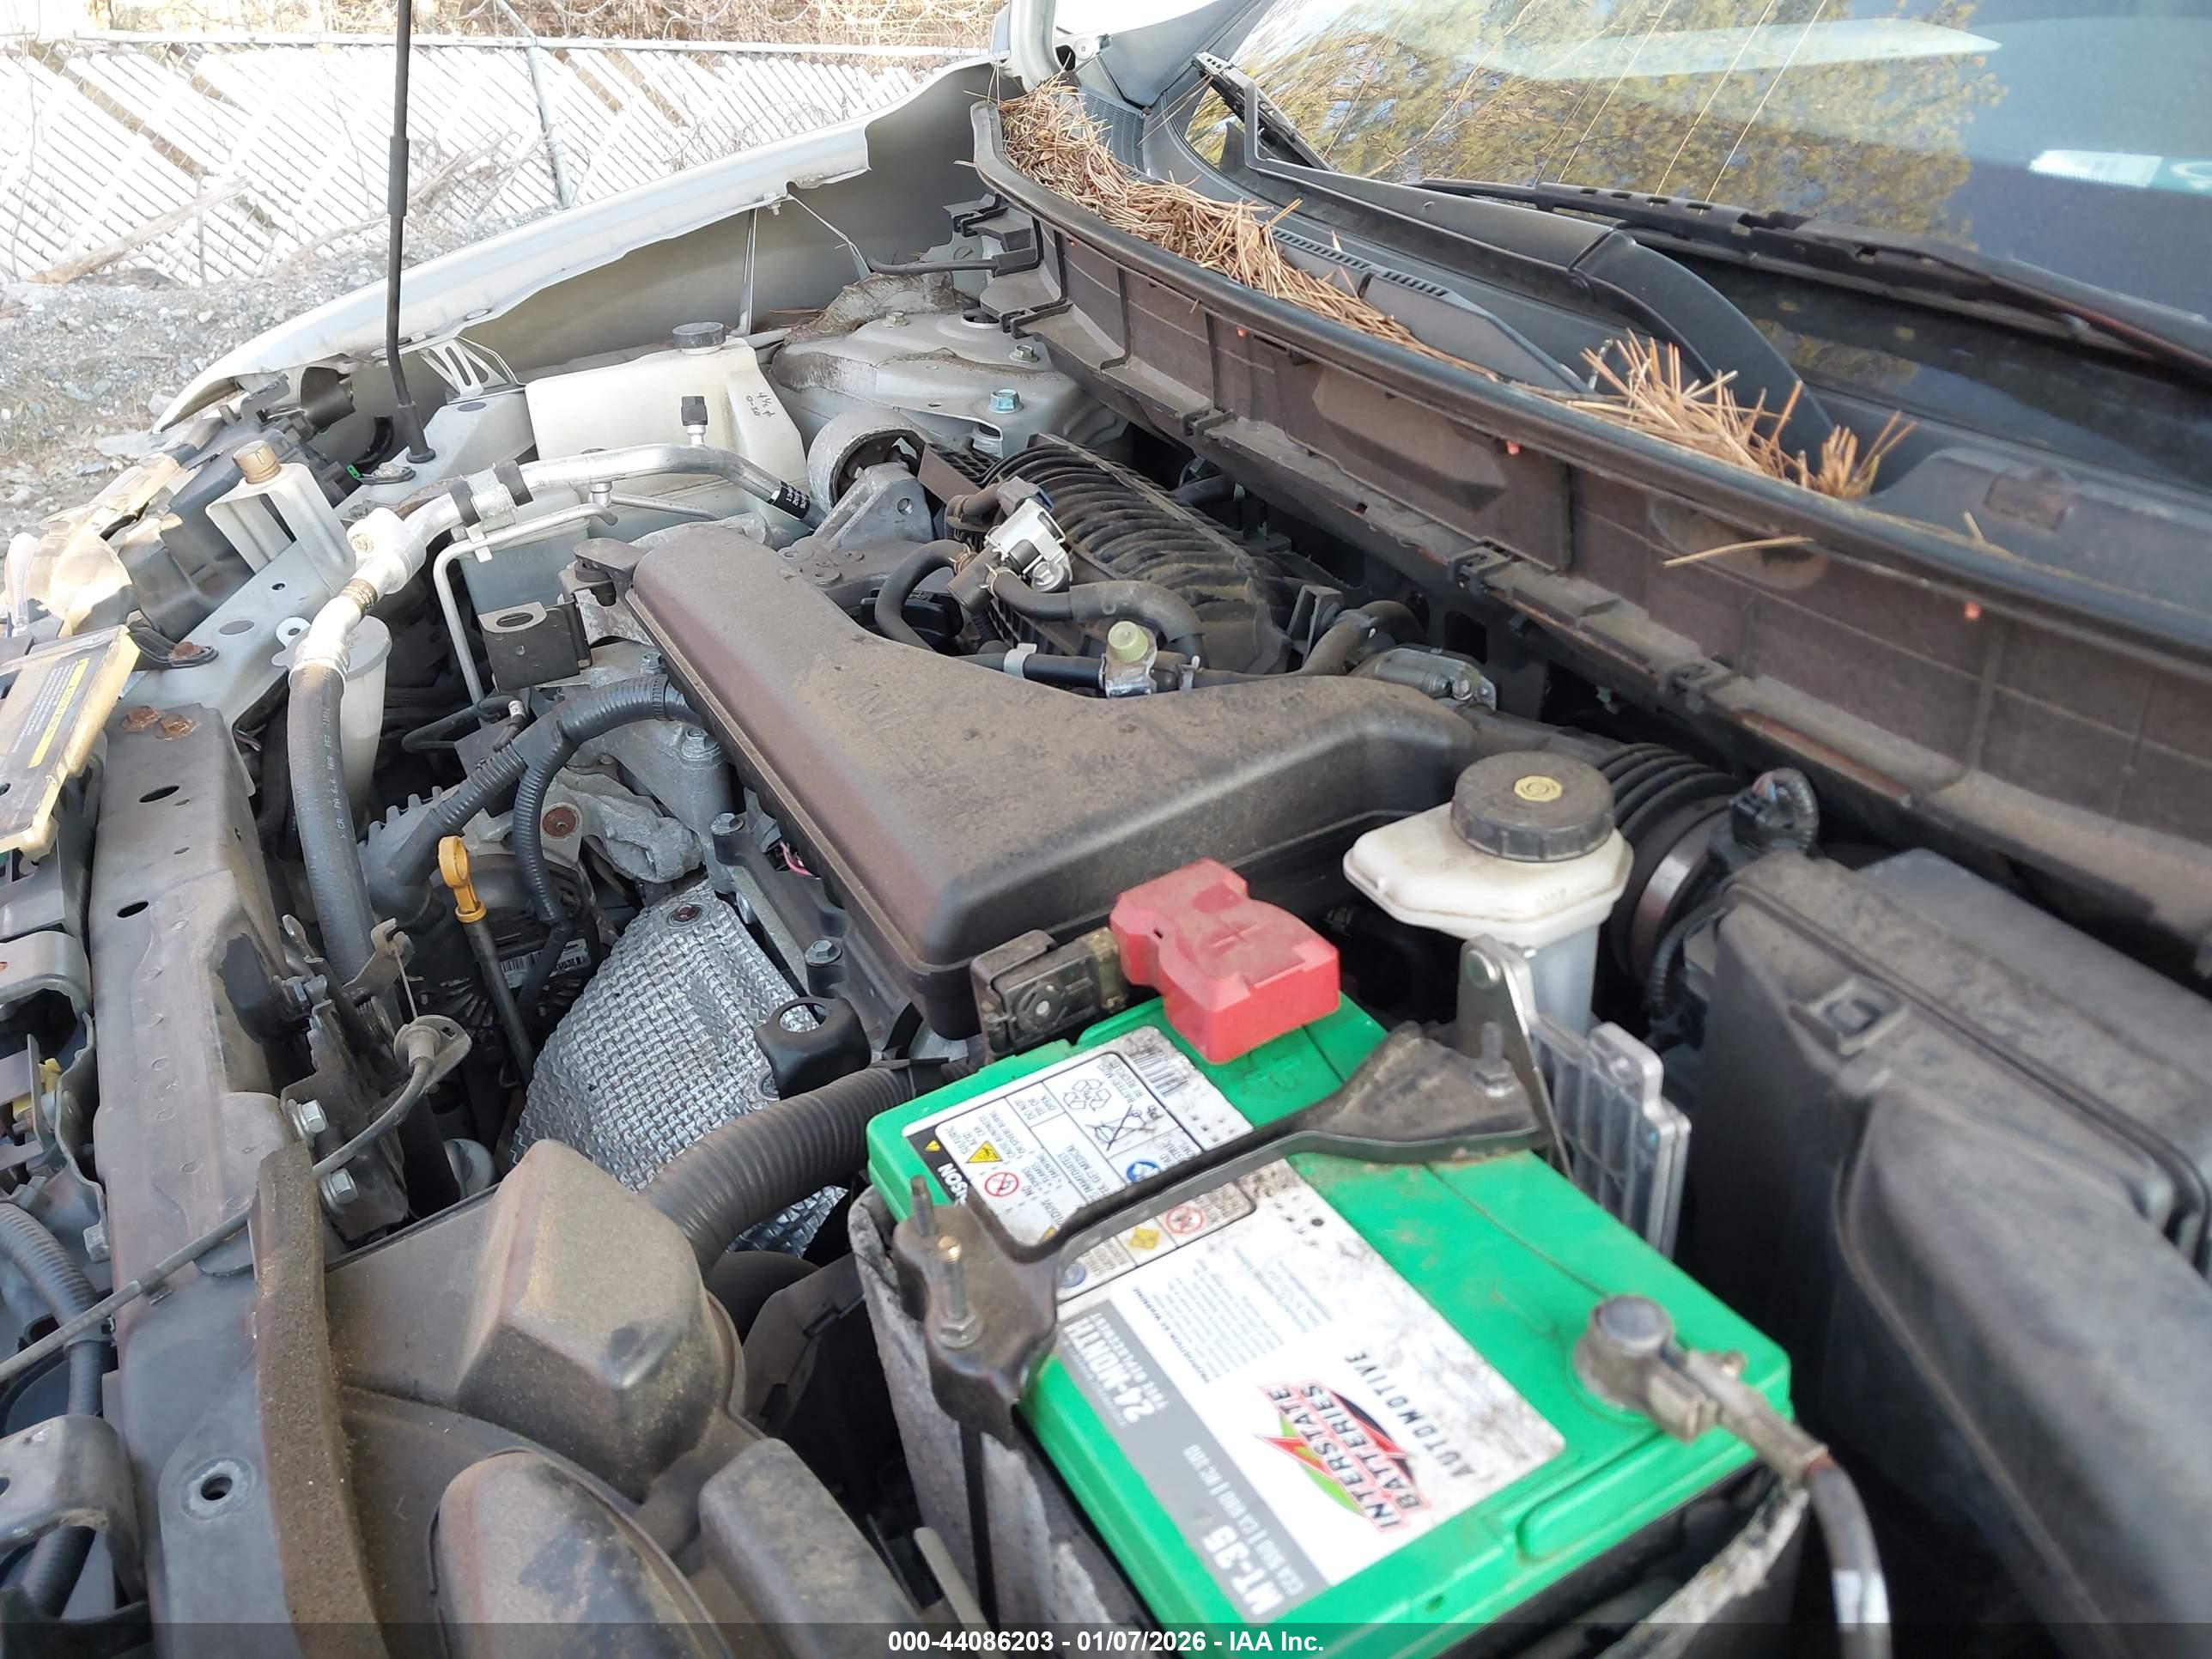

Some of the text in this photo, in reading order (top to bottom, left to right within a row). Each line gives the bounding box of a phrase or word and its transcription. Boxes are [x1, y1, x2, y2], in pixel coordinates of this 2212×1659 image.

[943, 1125, 970, 1154] SULFURIC
[1054, 1152, 1093, 1193] IMMEDIATELY
[1064, 1143, 1091, 1170] MEDICAL
[1020, 1184, 1034, 1196] NO
[1085, 1170, 1102, 1182] GET
[1062, 1316, 1158, 1425] 24-MONTH
[1299, 1382, 1420, 1512] BATTERIES
[1343, 1349, 1475, 1481] AUTOMOTIVE
[1267, 1384, 1399, 1532] INTERSTATE
[1200, 1522, 1285, 1617] MT-35
